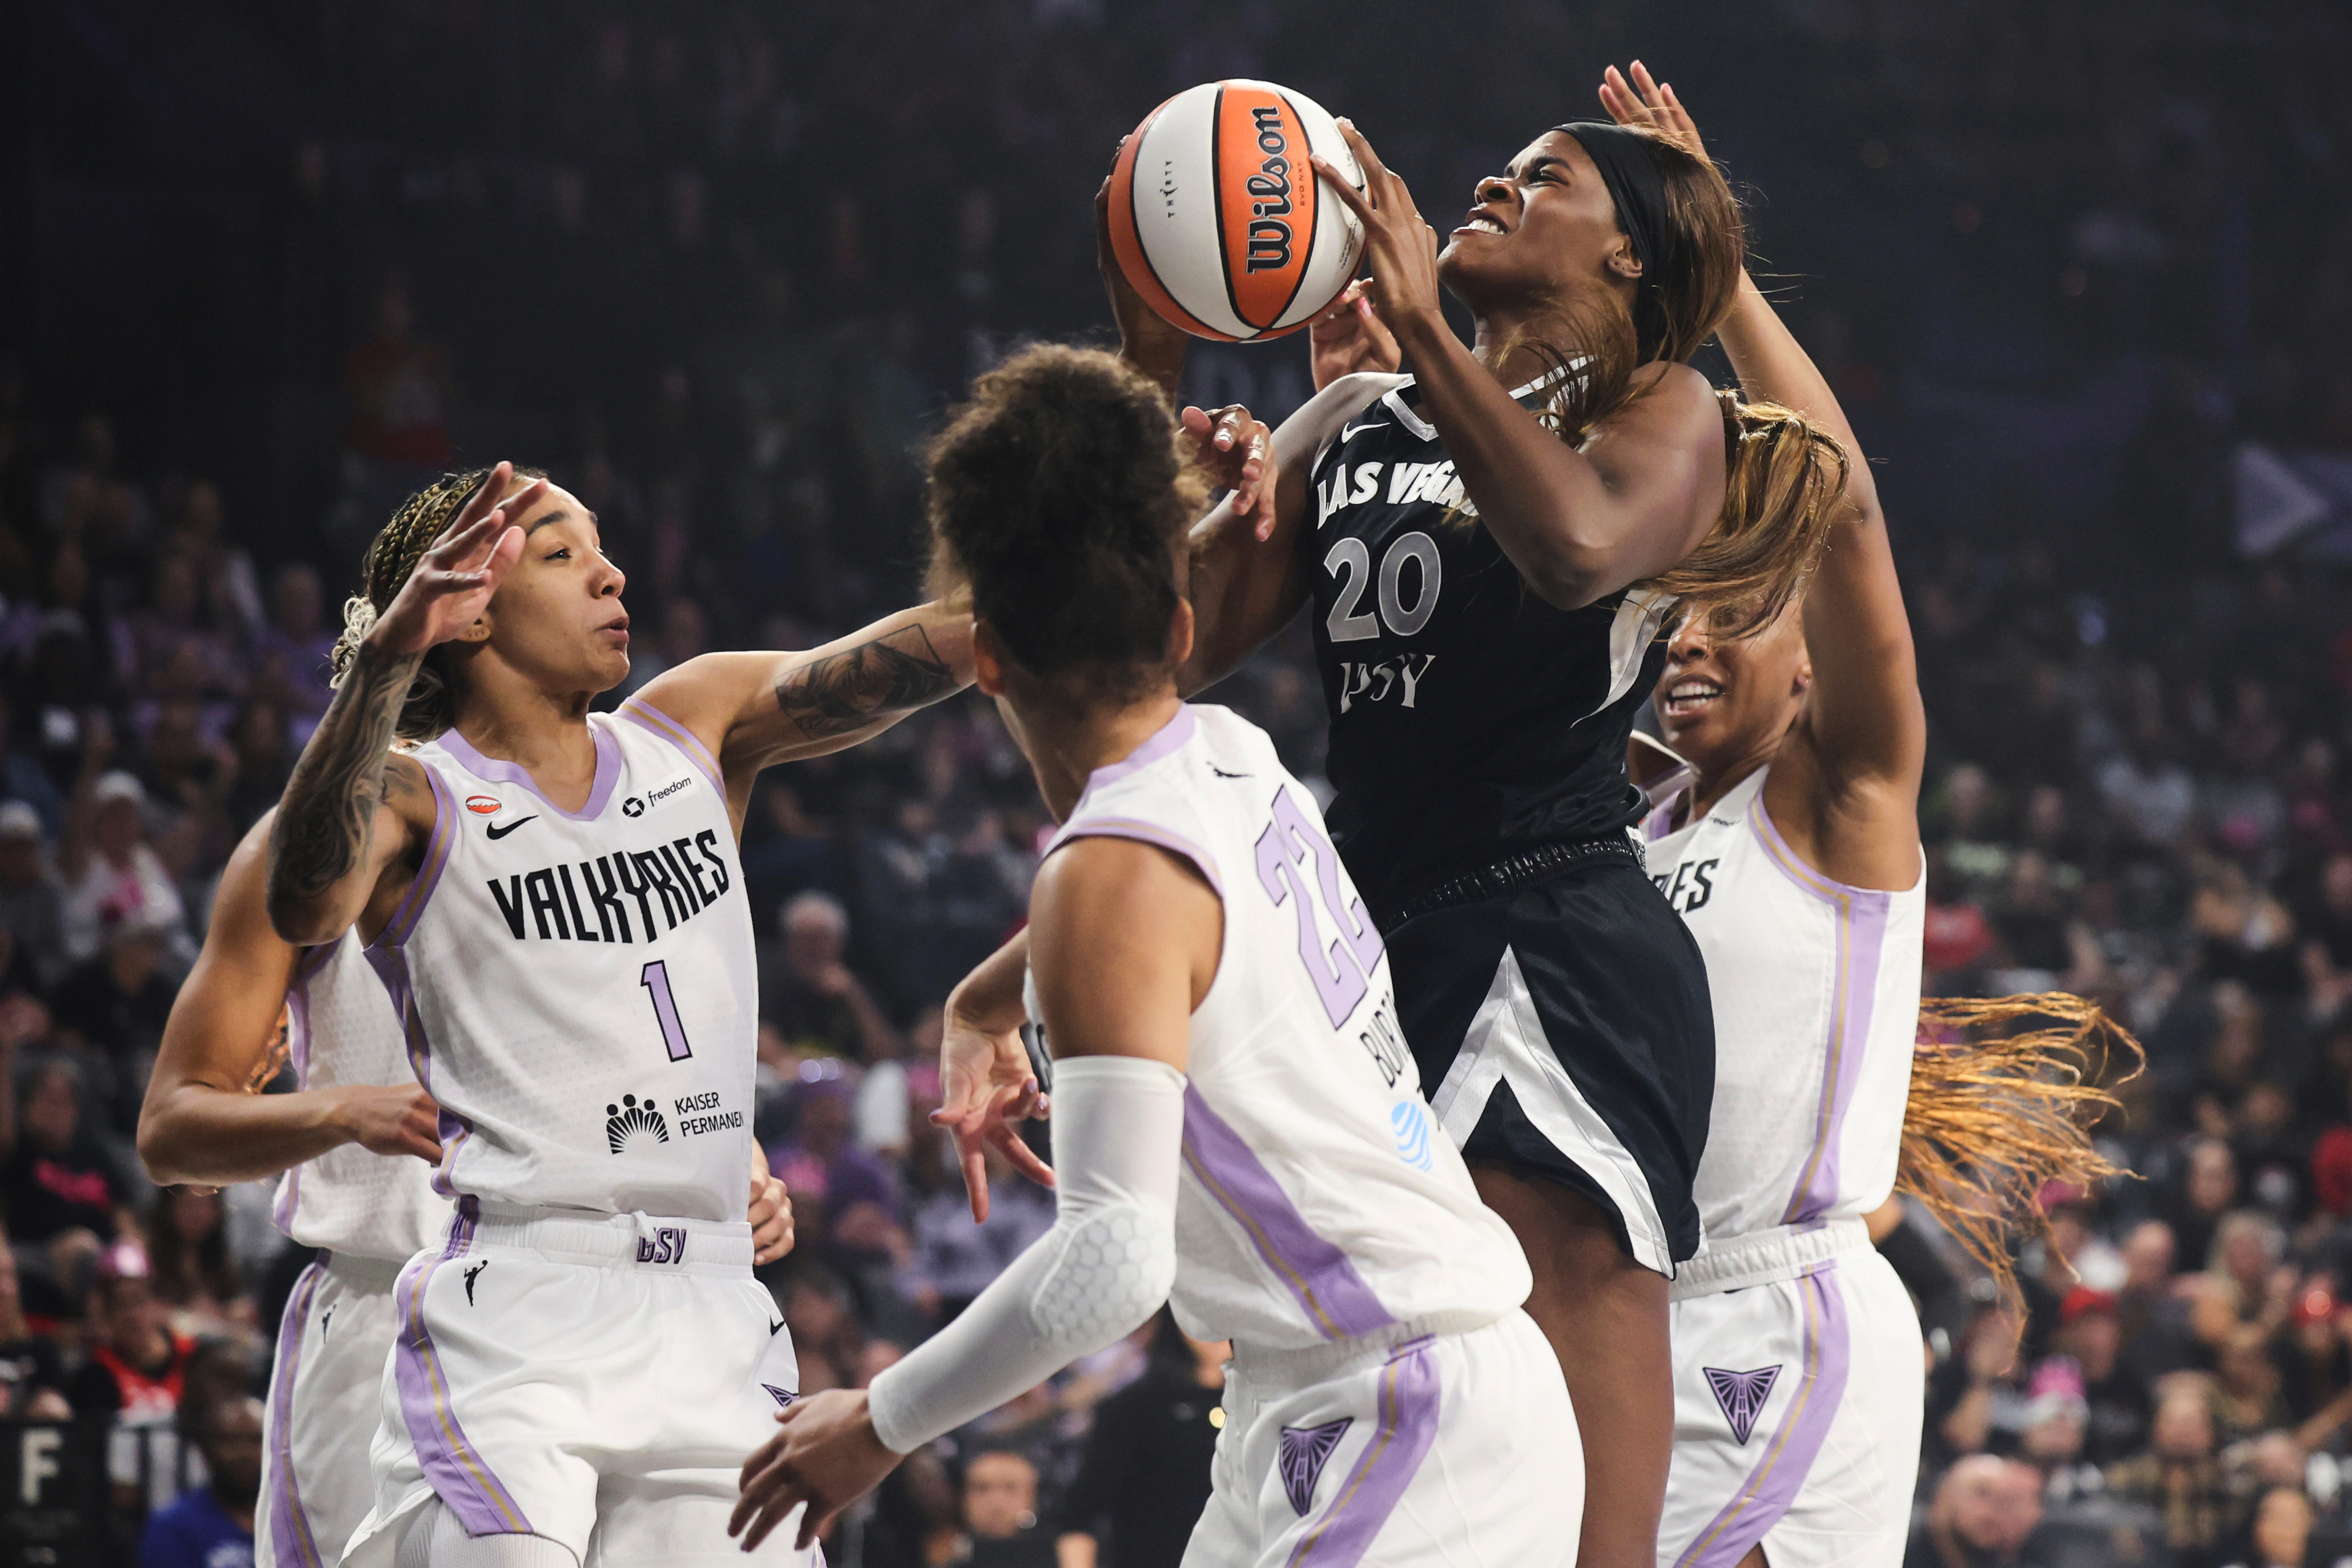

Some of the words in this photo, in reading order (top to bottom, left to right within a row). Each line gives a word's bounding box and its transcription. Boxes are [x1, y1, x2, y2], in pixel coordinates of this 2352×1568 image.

[1246, 105, 1293, 275] Wilson
[1317, 461, 1385, 530] LAS
[1323, 531, 1442, 643] 20
[647, 775, 692, 808] freedom
[486, 828, 730, 944] VALKYRIES
[1254, 783, 1386, 1031] 22
[640, 959, 693, 1063] 1
[674, 1091, 721, 1116] KAISER
